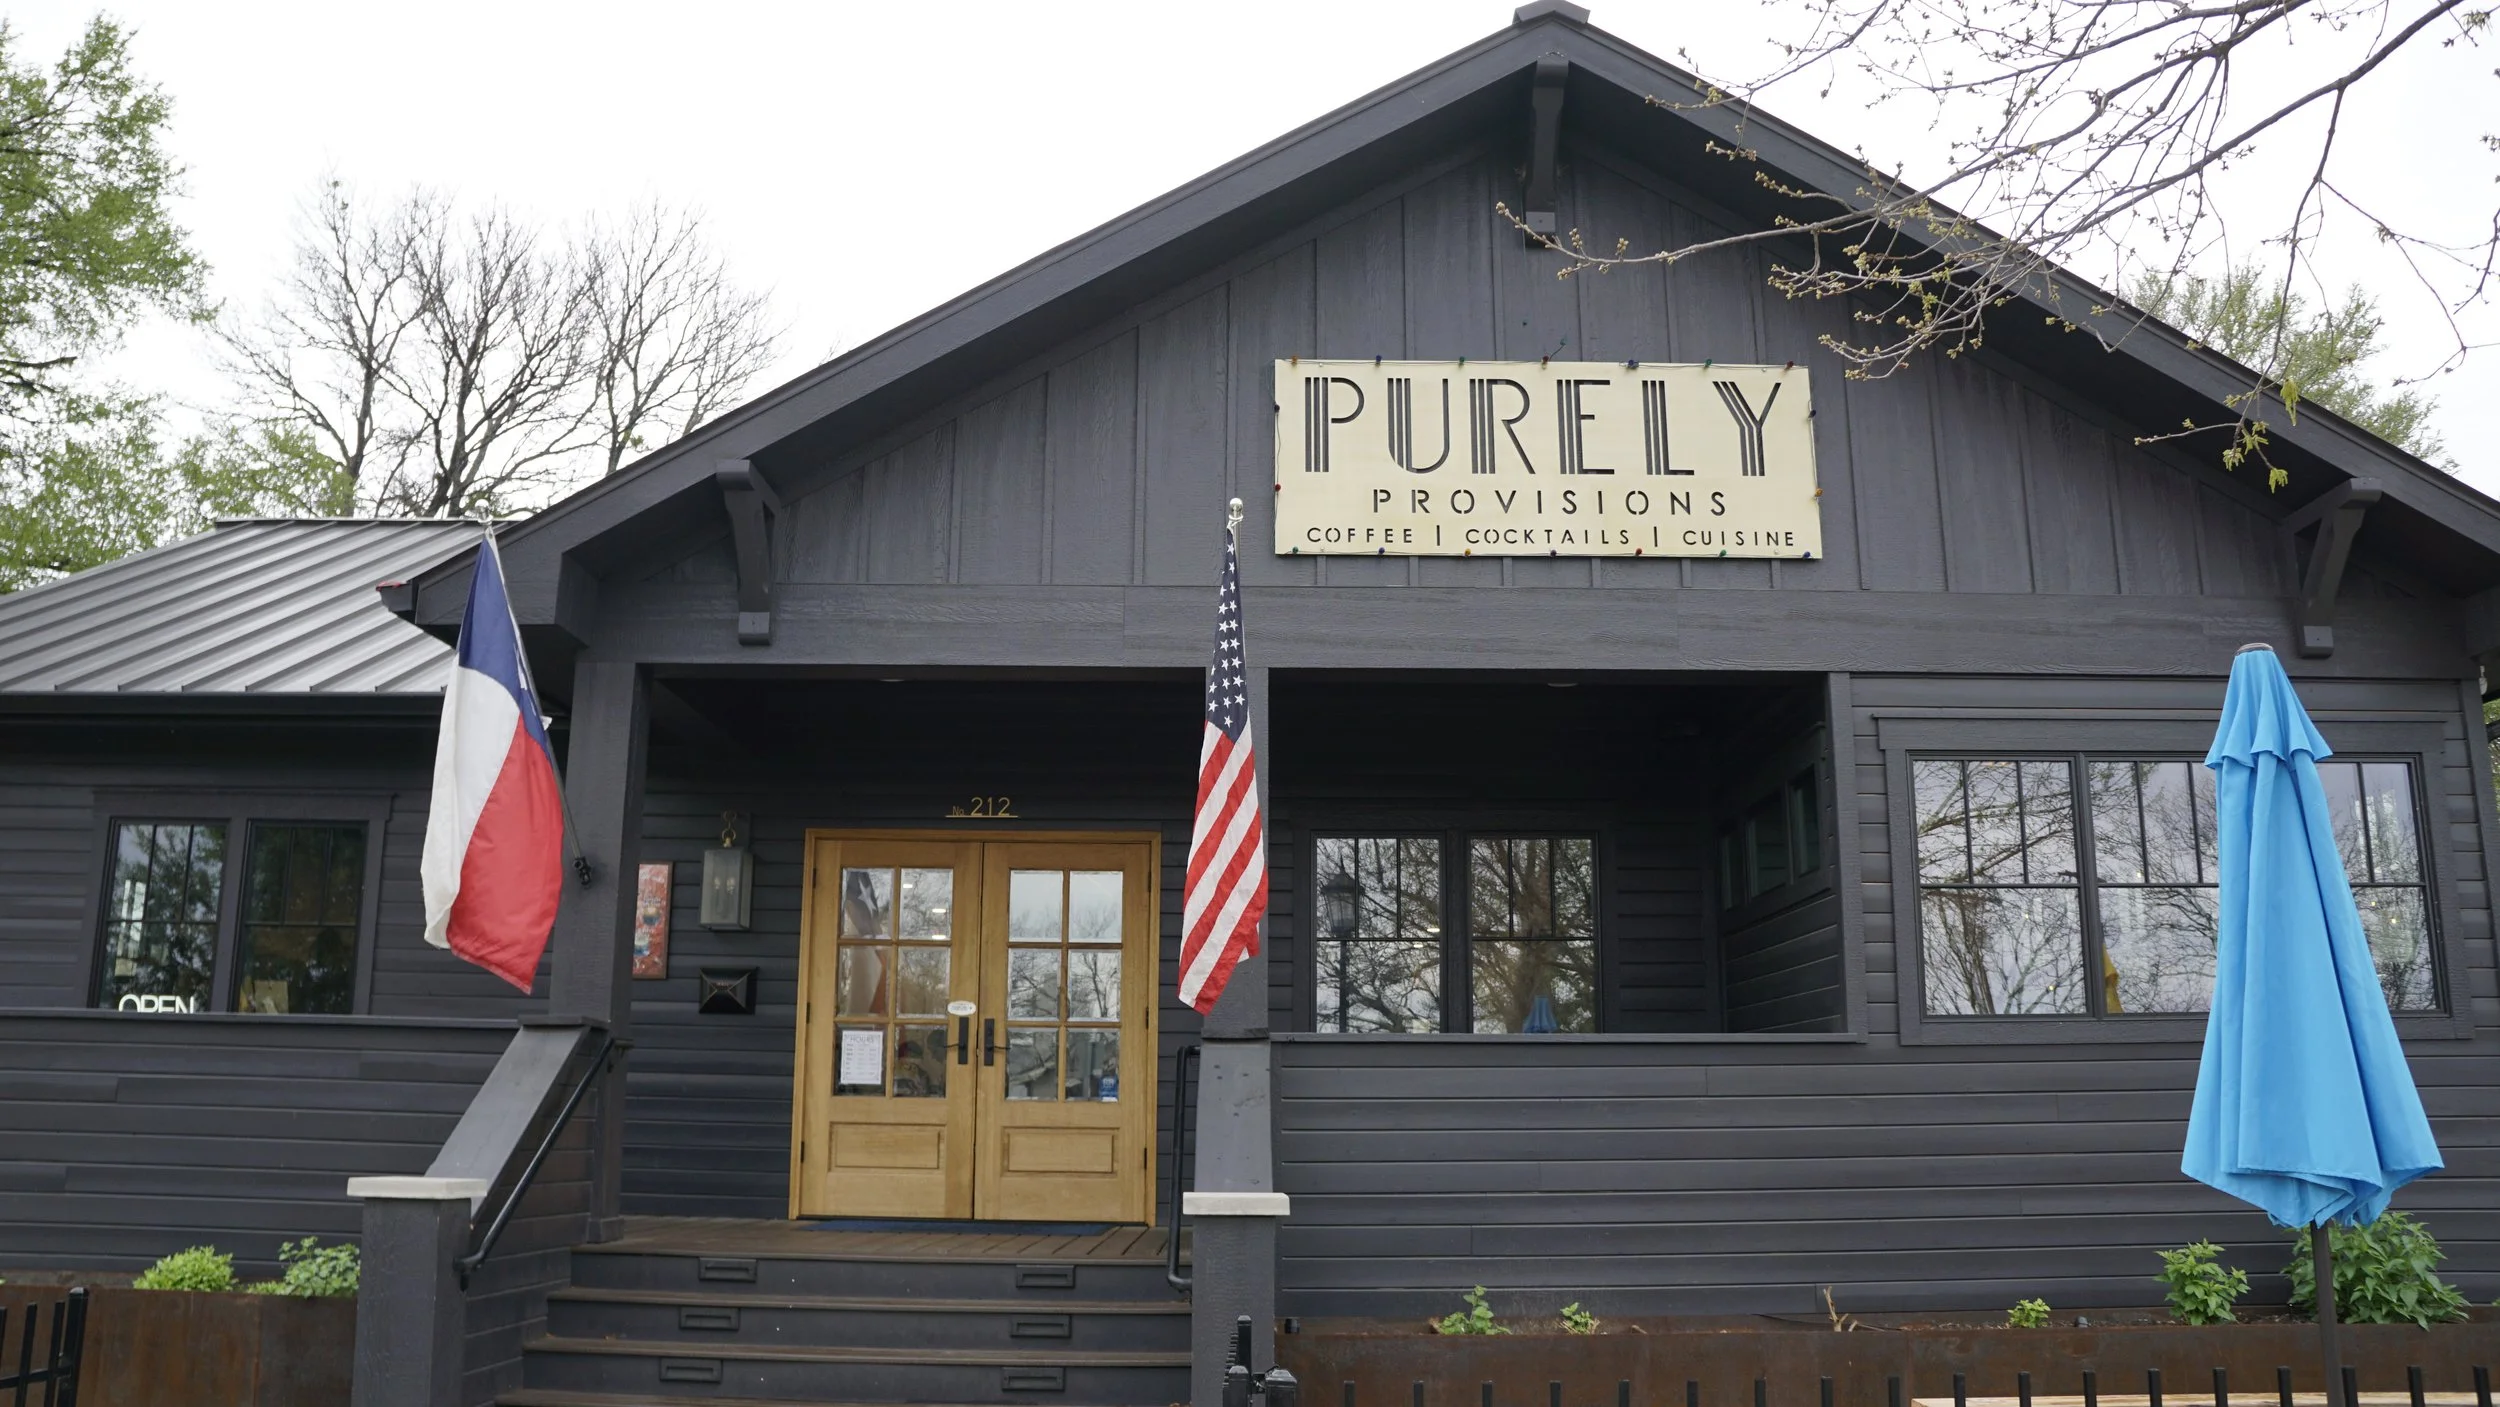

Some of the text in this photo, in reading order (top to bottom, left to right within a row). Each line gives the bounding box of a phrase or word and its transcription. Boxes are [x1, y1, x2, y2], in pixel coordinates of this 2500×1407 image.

[1304, 376, 1782, 476] PURELY
[1372, 488, 1726, 516] PROVISIONS
[1306, 527, 1413, 544] COFFEE
[1465, 528, 1630, 545] COCKTAILS
[1682, 529, 1794, 547] CUISINE
[970, 797, 1010, 816] 212
